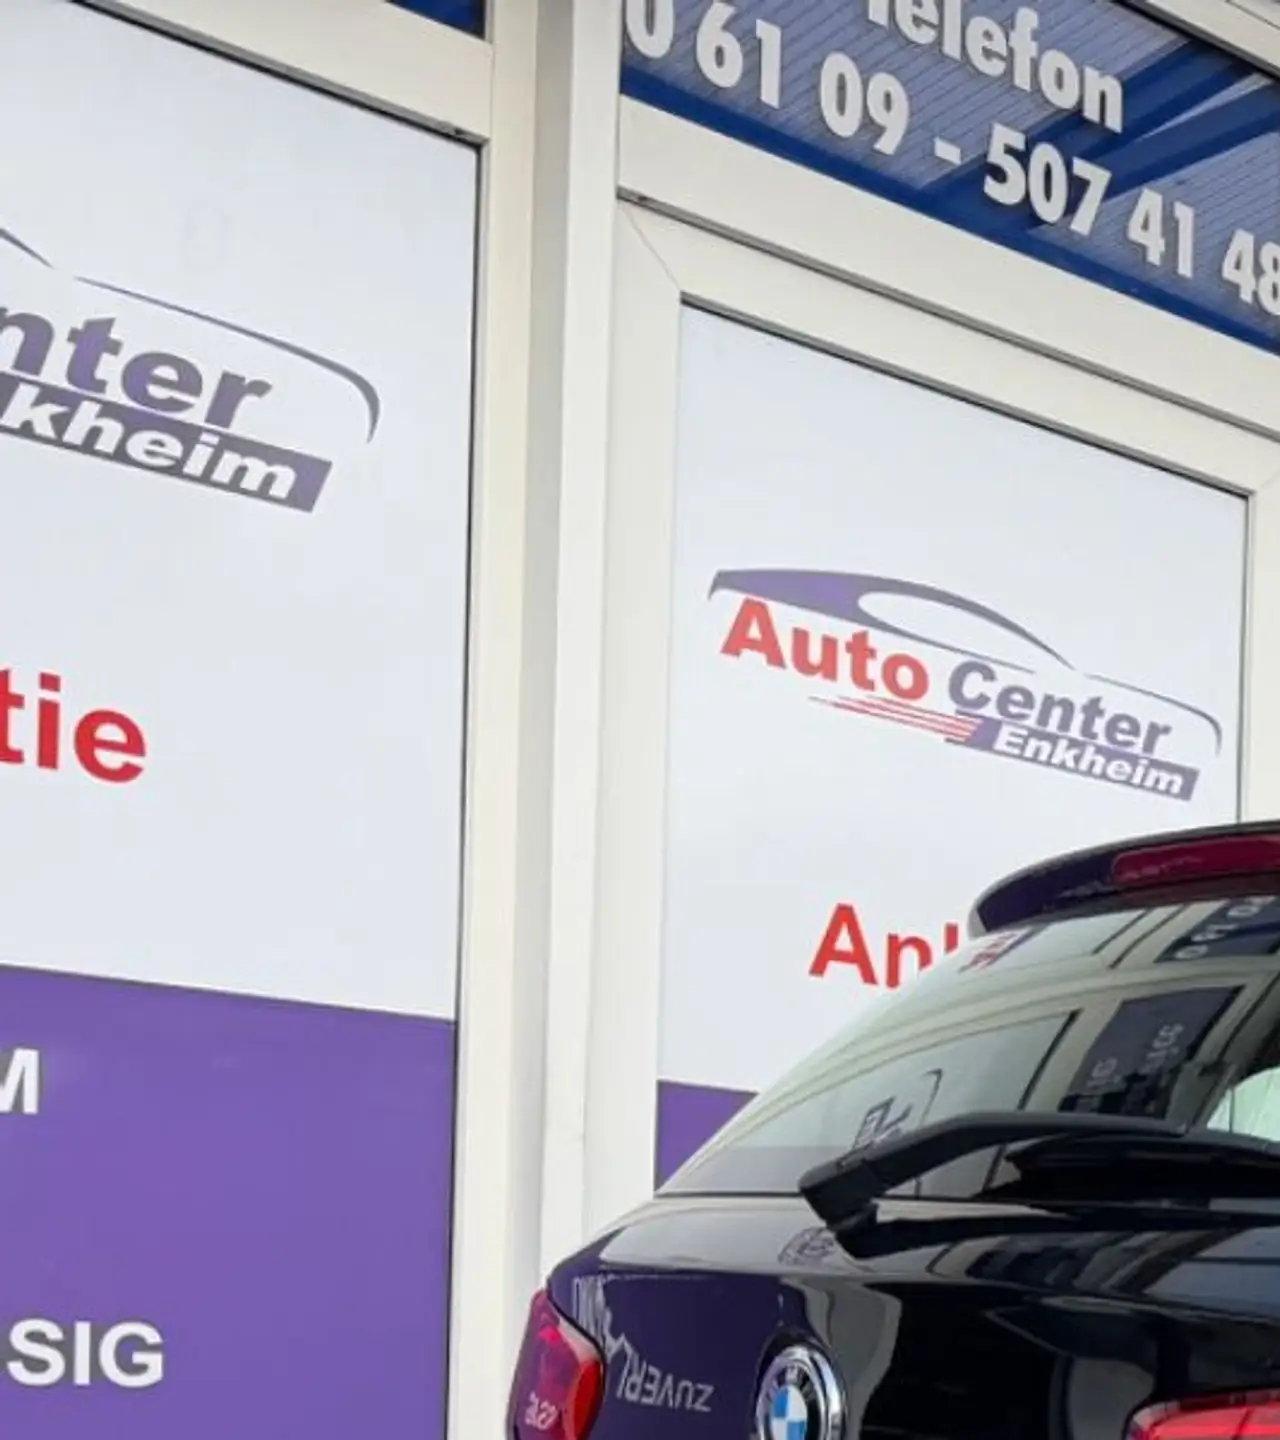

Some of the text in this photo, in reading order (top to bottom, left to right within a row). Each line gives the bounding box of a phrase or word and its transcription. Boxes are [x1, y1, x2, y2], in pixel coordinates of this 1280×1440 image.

[695, 2, 781, 109] 61
[820, 52, 909, 155] 09
[983, 122, 1112, 236] 507
[1127, 189, 1195, 278] 41
[720, 597, 1172, 755] Auto Center
[992, 721, 1184, 796] Enkheim
[6, 1318, 164, 1388] SIG
